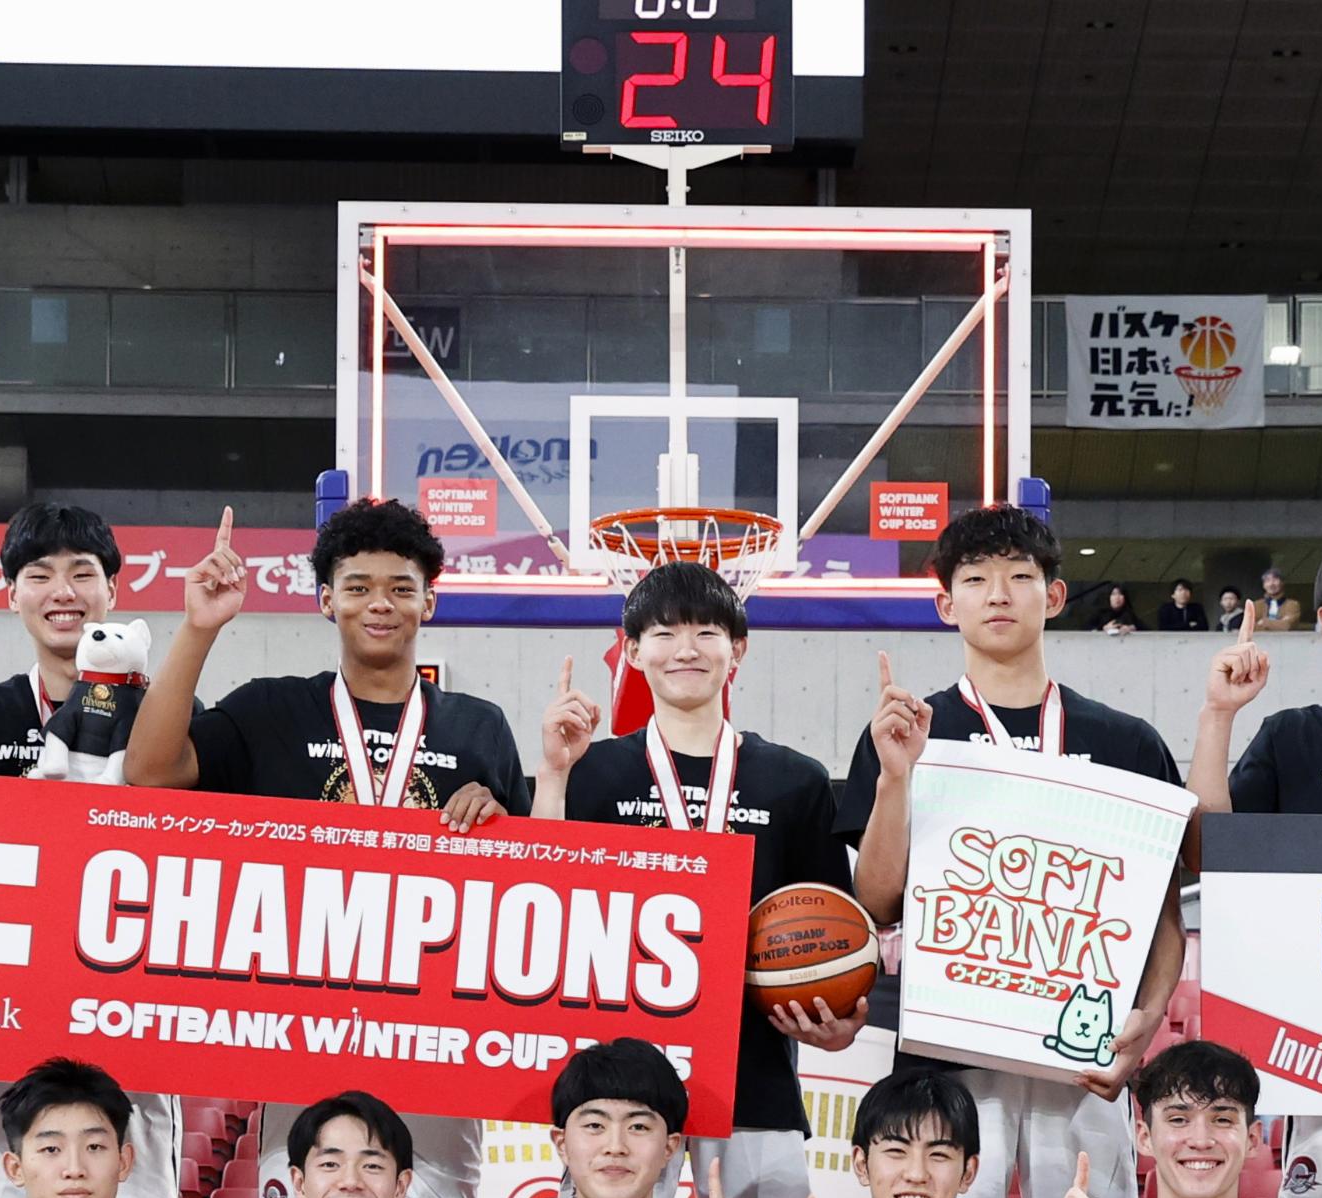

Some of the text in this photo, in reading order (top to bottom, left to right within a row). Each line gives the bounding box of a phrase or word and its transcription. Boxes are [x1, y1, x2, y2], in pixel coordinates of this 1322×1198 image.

[620, 32, 774, 128] 24
[650, 130, 704, 142] SEIKO
[1090, 347, 1172, 376] 日本を
[427, 489, 488, 501] SOFTBANK
[879, 493, 939, 504] SOFTBANK
[428, 500, 474, 513] WINTER
[879, 504, 925, 517] WINTER
[428, 515, 487, 527] CUP 2025
[879, 519, 937, 530] CUP 2025
[728, 807, 771, 826] 2025
[88, 809, 708, 874] SoftBank ウインターカップ2025 令和7年度 第78回 全国高等学校バスケットボール選手権大会
[944, 826, 1125, 918] SOFT
[762, 896, 825, 916] molten
[76, 849, 705, 1016] CHAMPIONS
[767, 928, 825, 946] SOFTBANK
[913, 886, 1131, 990] BANK
[750, 939, 849, 964] WINTER CUP 2025
[950, 963, 1065, 998] ウインターカップ
[69, 998, 292, 1050] SOFTBANK
[301, 1007, 470, 1065] WINTER
[476, 1030, 568, 1071] CUP
